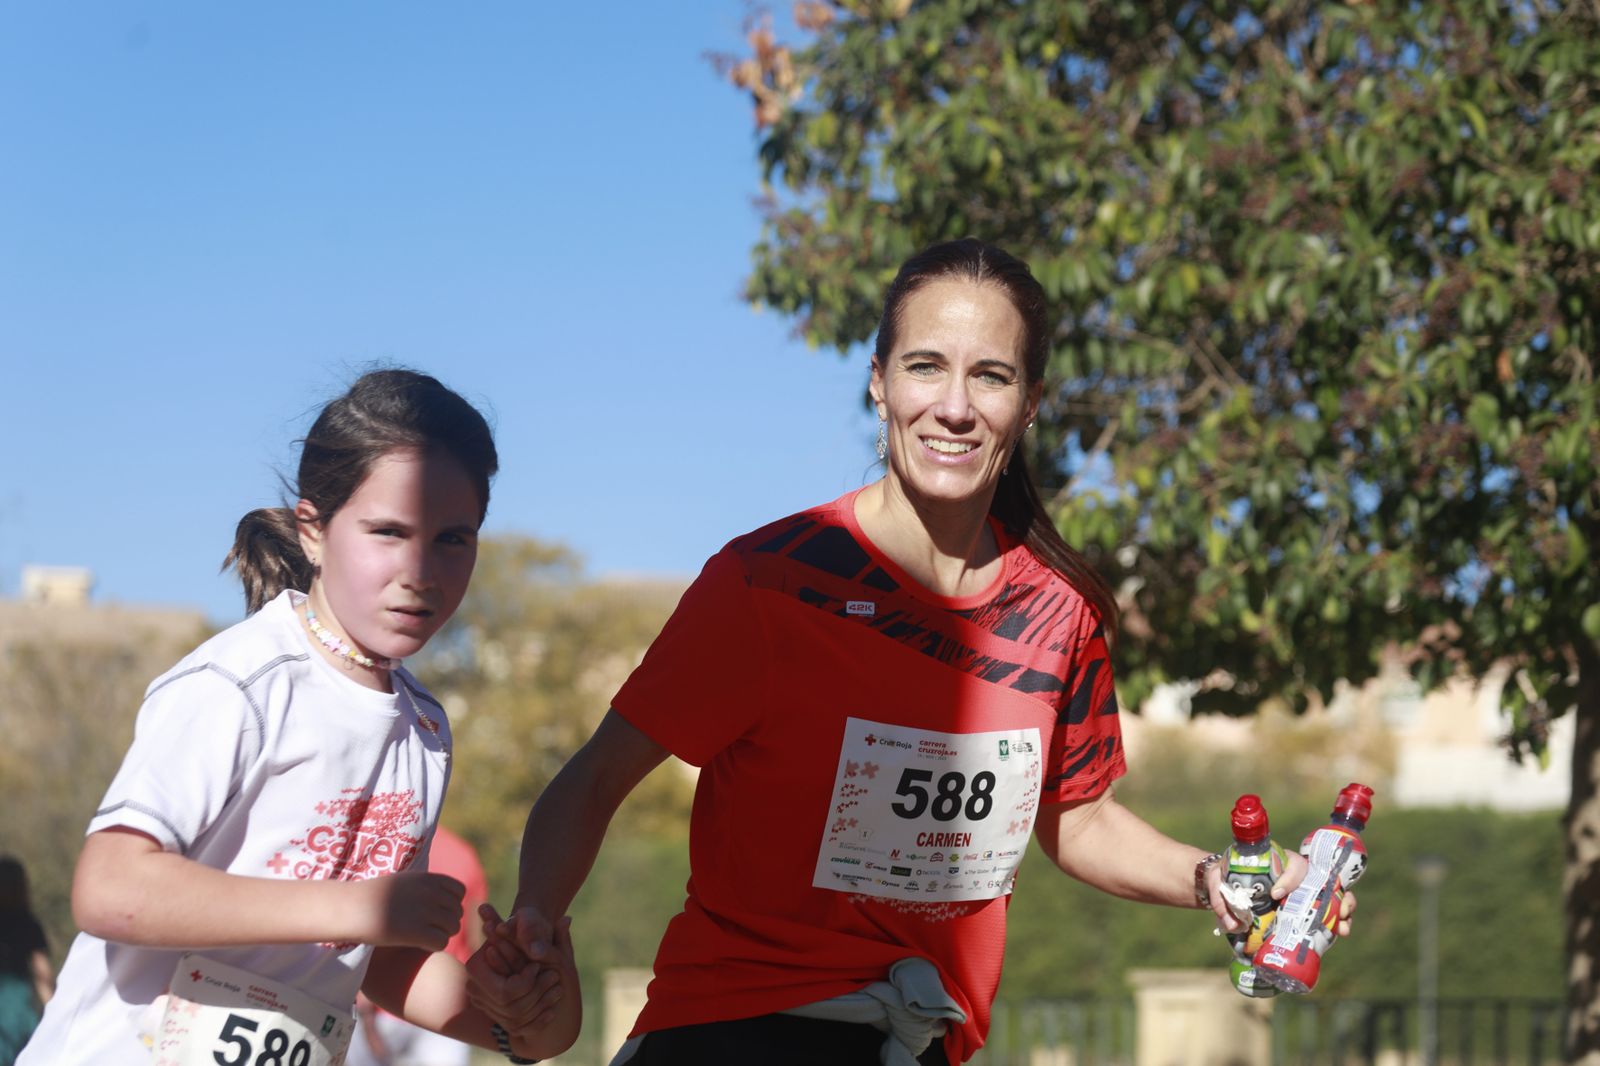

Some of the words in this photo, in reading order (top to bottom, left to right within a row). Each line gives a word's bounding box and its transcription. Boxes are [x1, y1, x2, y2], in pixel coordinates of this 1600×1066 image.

[848, 604, 873, 612] 42K
[896, 741, 912, 750] Roja
[919, 740, 947, 749] carrera
[918, 746, 958, 757] cruzroja.es
[891, 768, 996, 822] 588
[916, 832, 972, 848] CARMEN
